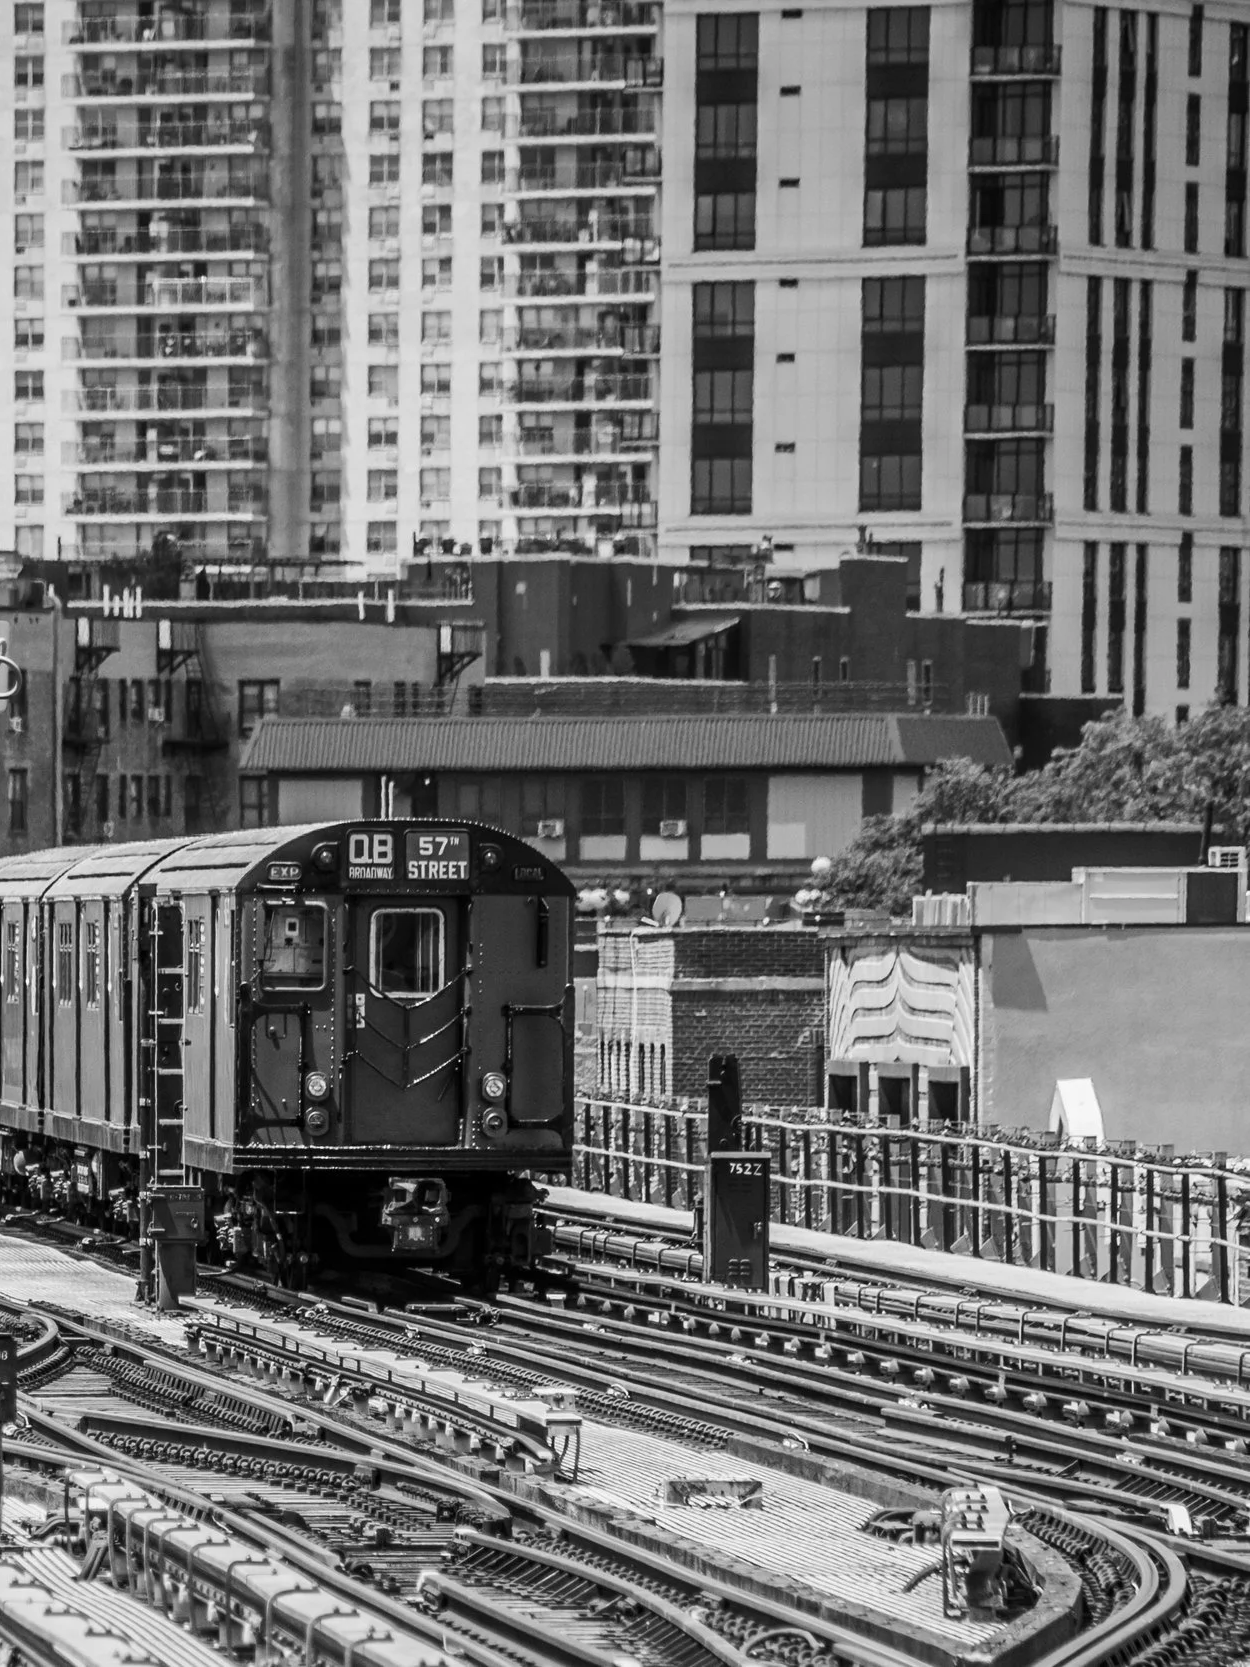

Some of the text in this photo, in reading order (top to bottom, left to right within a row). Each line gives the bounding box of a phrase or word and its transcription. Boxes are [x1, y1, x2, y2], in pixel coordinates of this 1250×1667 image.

[349, 834, 393, 864] QB
[270, 866, 299, 878] EXP
[349, 867, 393, 879] BROADWAY
[408, 861, 467, 879] STREET
